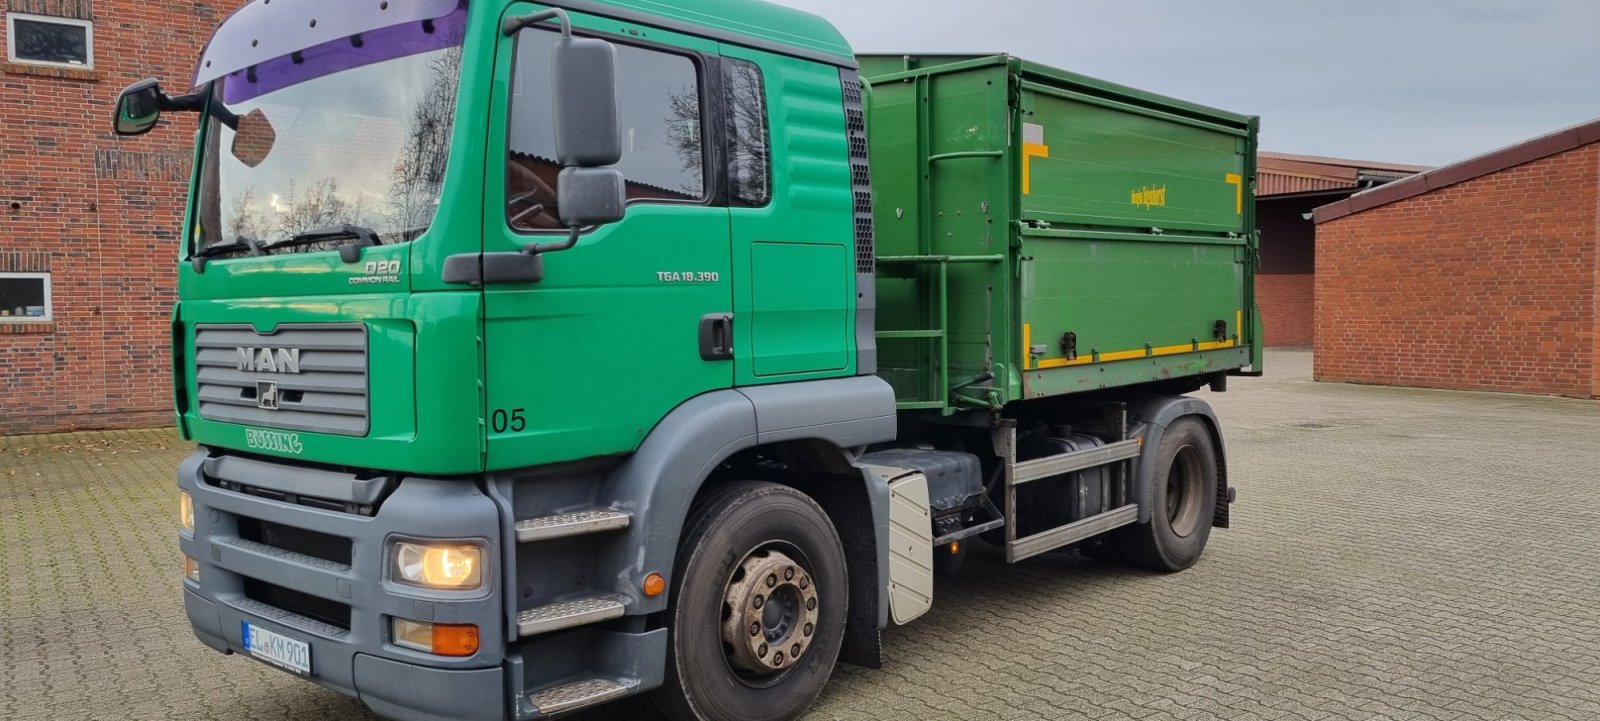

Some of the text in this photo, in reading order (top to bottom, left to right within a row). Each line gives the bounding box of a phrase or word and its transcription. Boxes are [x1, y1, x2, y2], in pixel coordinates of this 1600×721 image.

[348, 275, 401, 285] COMMON RAIL
[656, 271, 680, 282] TGA
[236, 346, 300, 373] MAN
[491, 407, 526, 434] 05
[250, 628, 264, 652] EL
[269, 634, 285, 660] KM
[286, 640, 309, 669] 901
